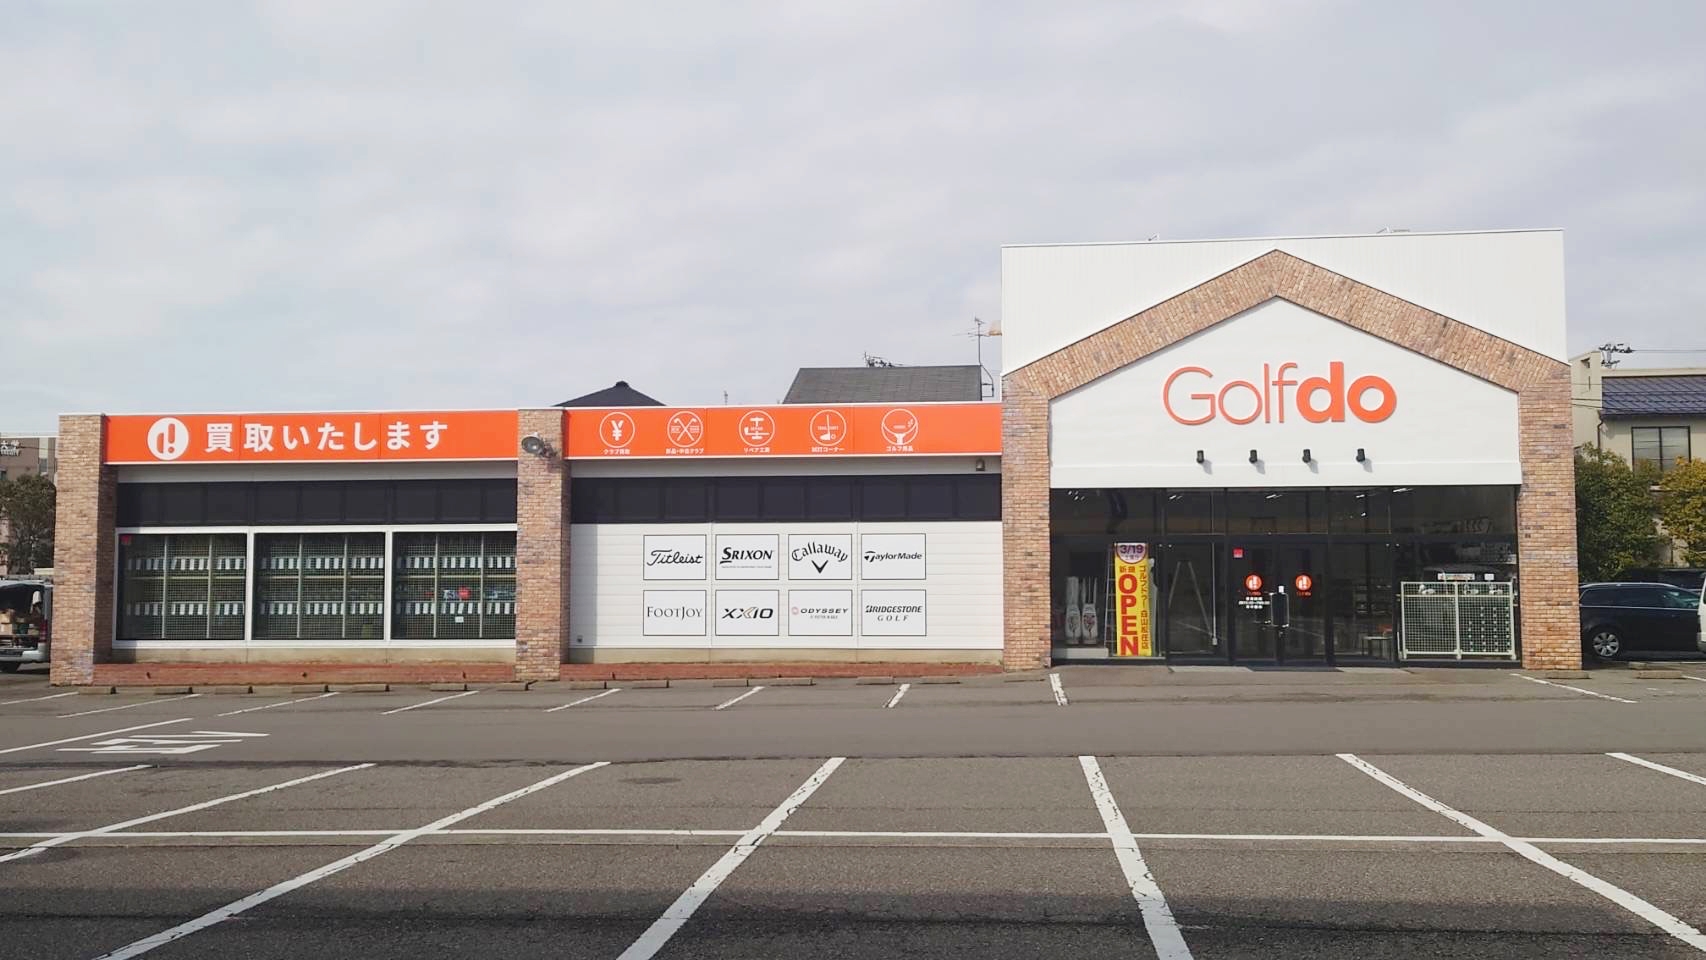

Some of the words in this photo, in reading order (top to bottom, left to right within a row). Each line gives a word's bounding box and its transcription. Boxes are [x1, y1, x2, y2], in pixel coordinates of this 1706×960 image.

[1163, 361, 1397, 426] Golfdo
[205, 421, 448, 453] 買取いたします
[647, 549, 703, 566] Titleist
[720, 547, 774, 564] SRIXON
[791, 541, 848, 562] Callaway
[864, 551, 922, 562] TaylorMade
[1120, 544, 1144, 554] 3/19
[722, 607, 773, 619] XXIO
[865, 605, 922, 613] BRIDGESTONE
[1119, 574, 1138, 656] OPEN
